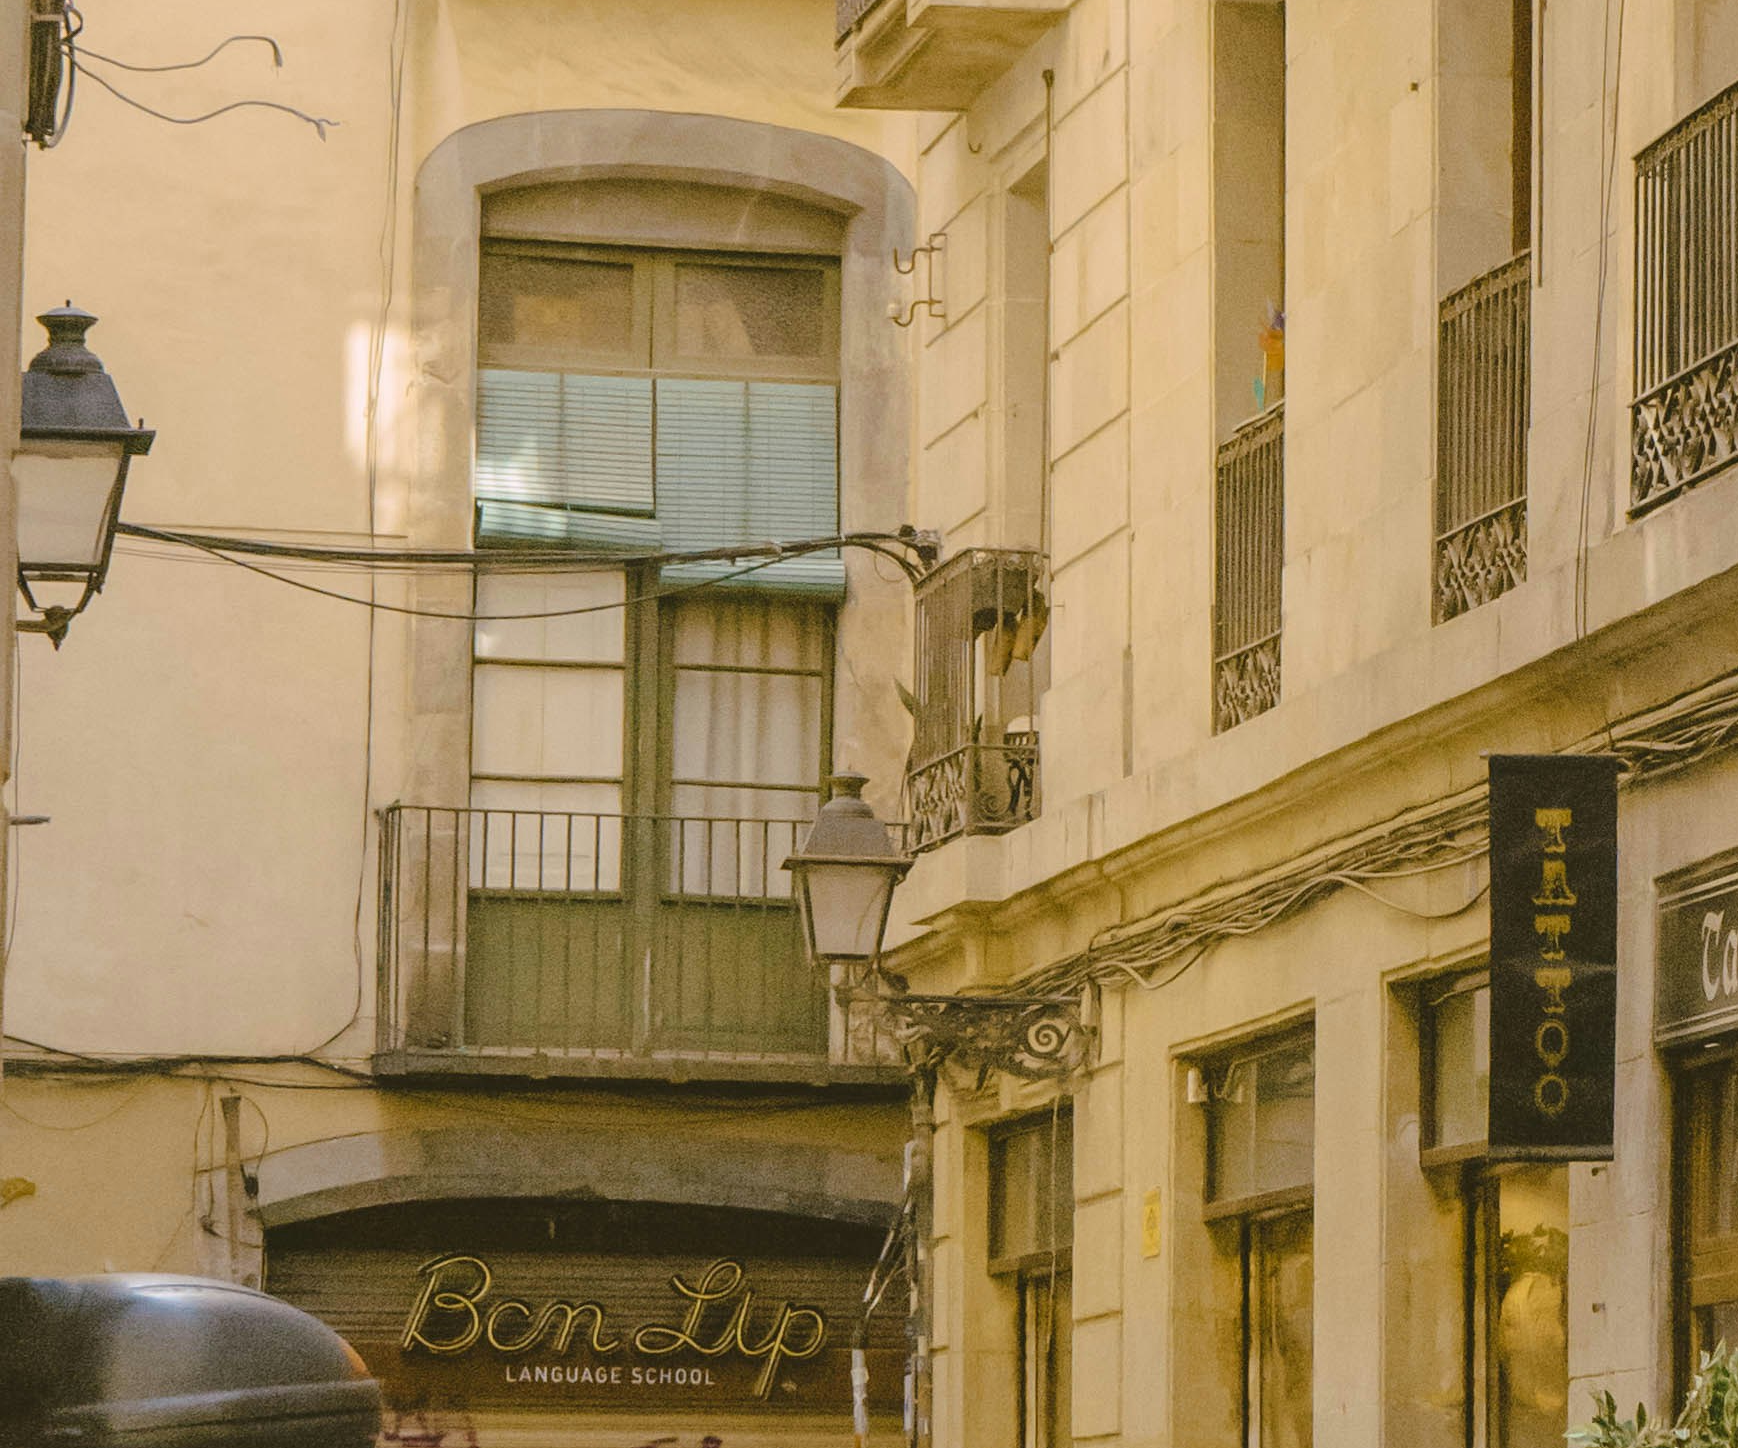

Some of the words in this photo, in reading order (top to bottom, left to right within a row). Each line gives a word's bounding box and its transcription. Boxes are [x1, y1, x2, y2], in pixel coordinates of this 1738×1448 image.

[1531, 807, 1577, 1118] TATTOO
[402, 1254, 619, 1352] Bcn
[505, 1365, 622, 1385] LANGUAGE
[630, 1366, 716, 1387] SCHOOL
